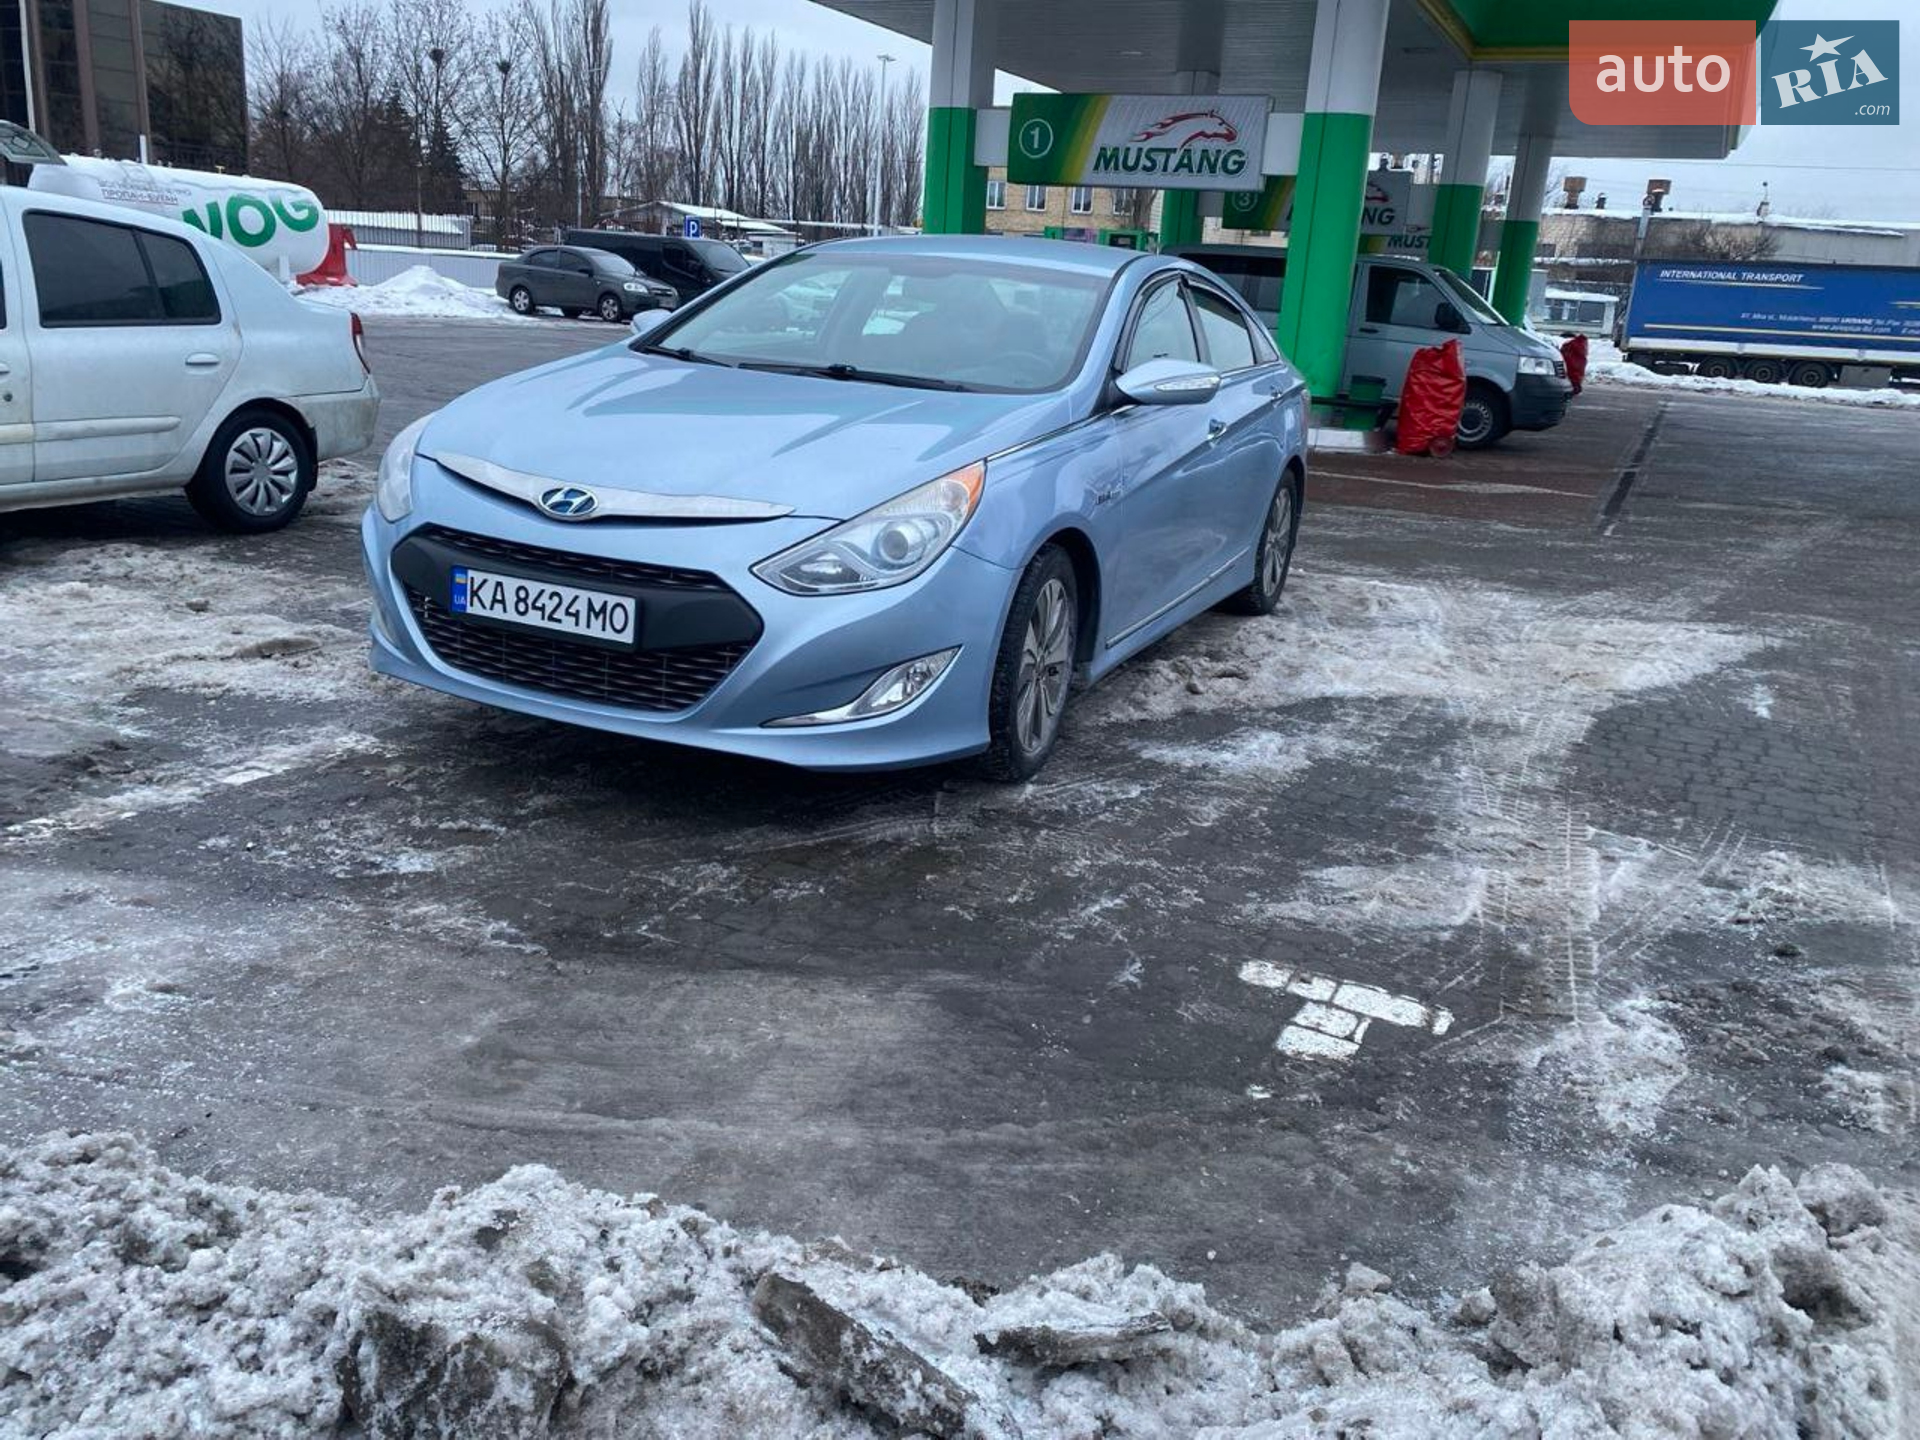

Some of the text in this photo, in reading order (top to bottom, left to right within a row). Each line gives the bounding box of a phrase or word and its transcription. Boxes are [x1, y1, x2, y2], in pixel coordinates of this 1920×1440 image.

[1030, 126, 1040, 149] 1
[1092, 145, 1248, 176] MUSTANG
[1659, 269, 1805, 283] INTERNATIONAL TRANSPORT
